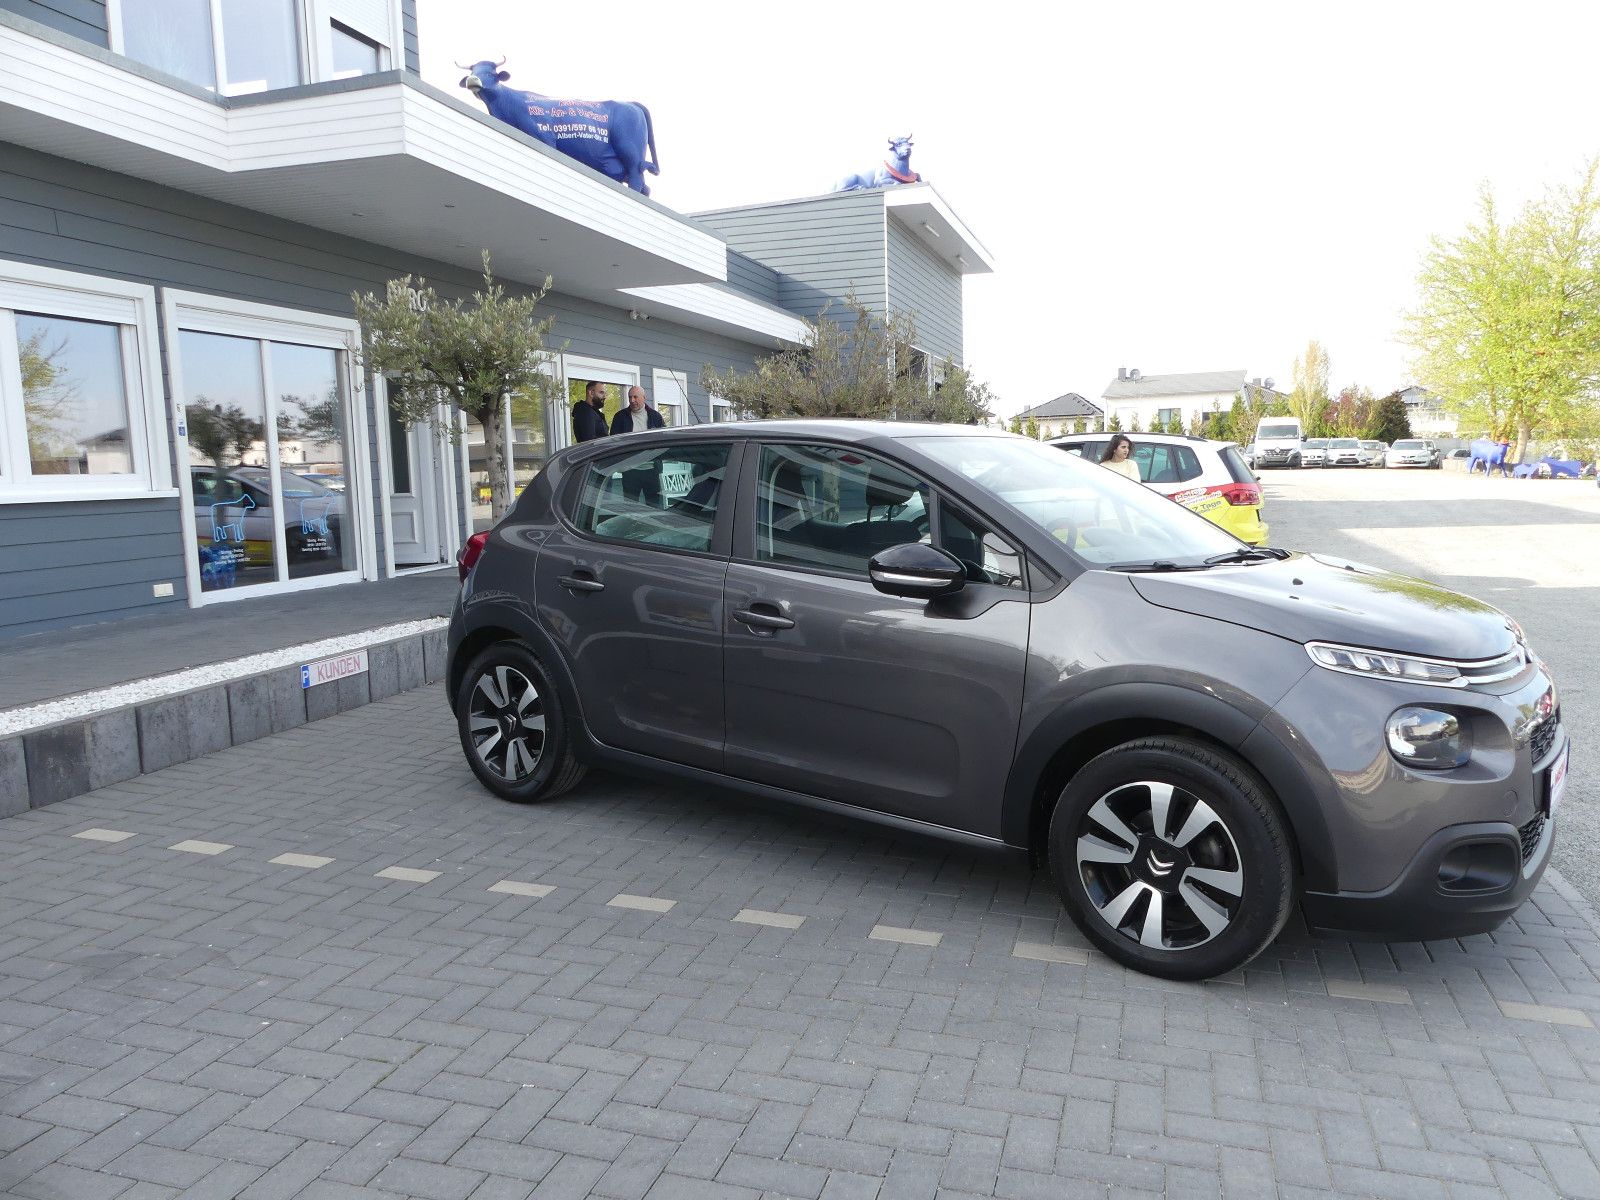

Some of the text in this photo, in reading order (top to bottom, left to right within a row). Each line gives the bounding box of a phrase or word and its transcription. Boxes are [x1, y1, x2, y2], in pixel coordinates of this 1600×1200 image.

[537, 123, 552, 132] Tel.
[553, 123, 587, 133] 0391/597
[302, 655, 361, 684] P KUNDEN
